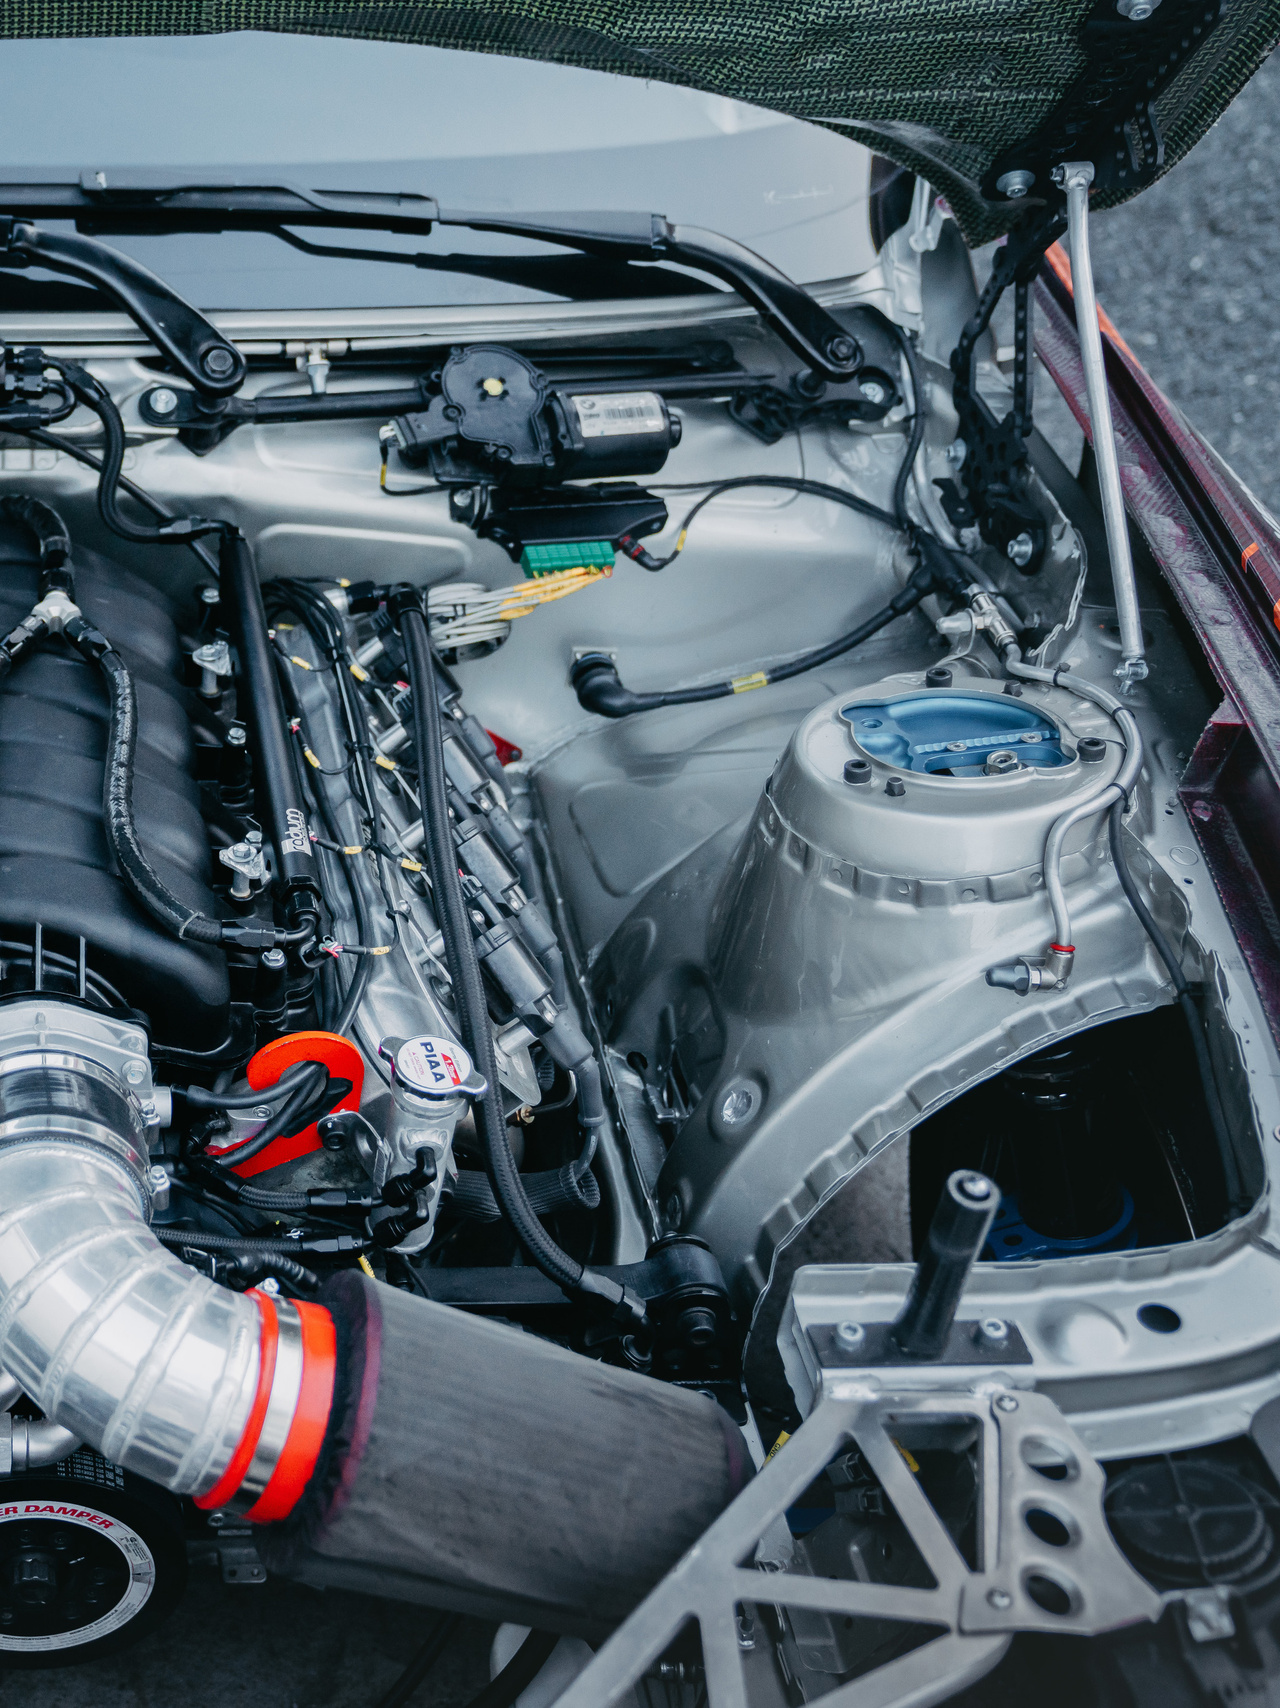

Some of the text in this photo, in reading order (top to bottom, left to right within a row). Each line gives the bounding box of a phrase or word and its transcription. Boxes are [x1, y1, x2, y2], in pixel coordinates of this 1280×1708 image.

[283, 808, 306, 854] radium
[419, 1041, 446, 1083] PIAA
[24, 1505, 115, 1529] DAMPER
